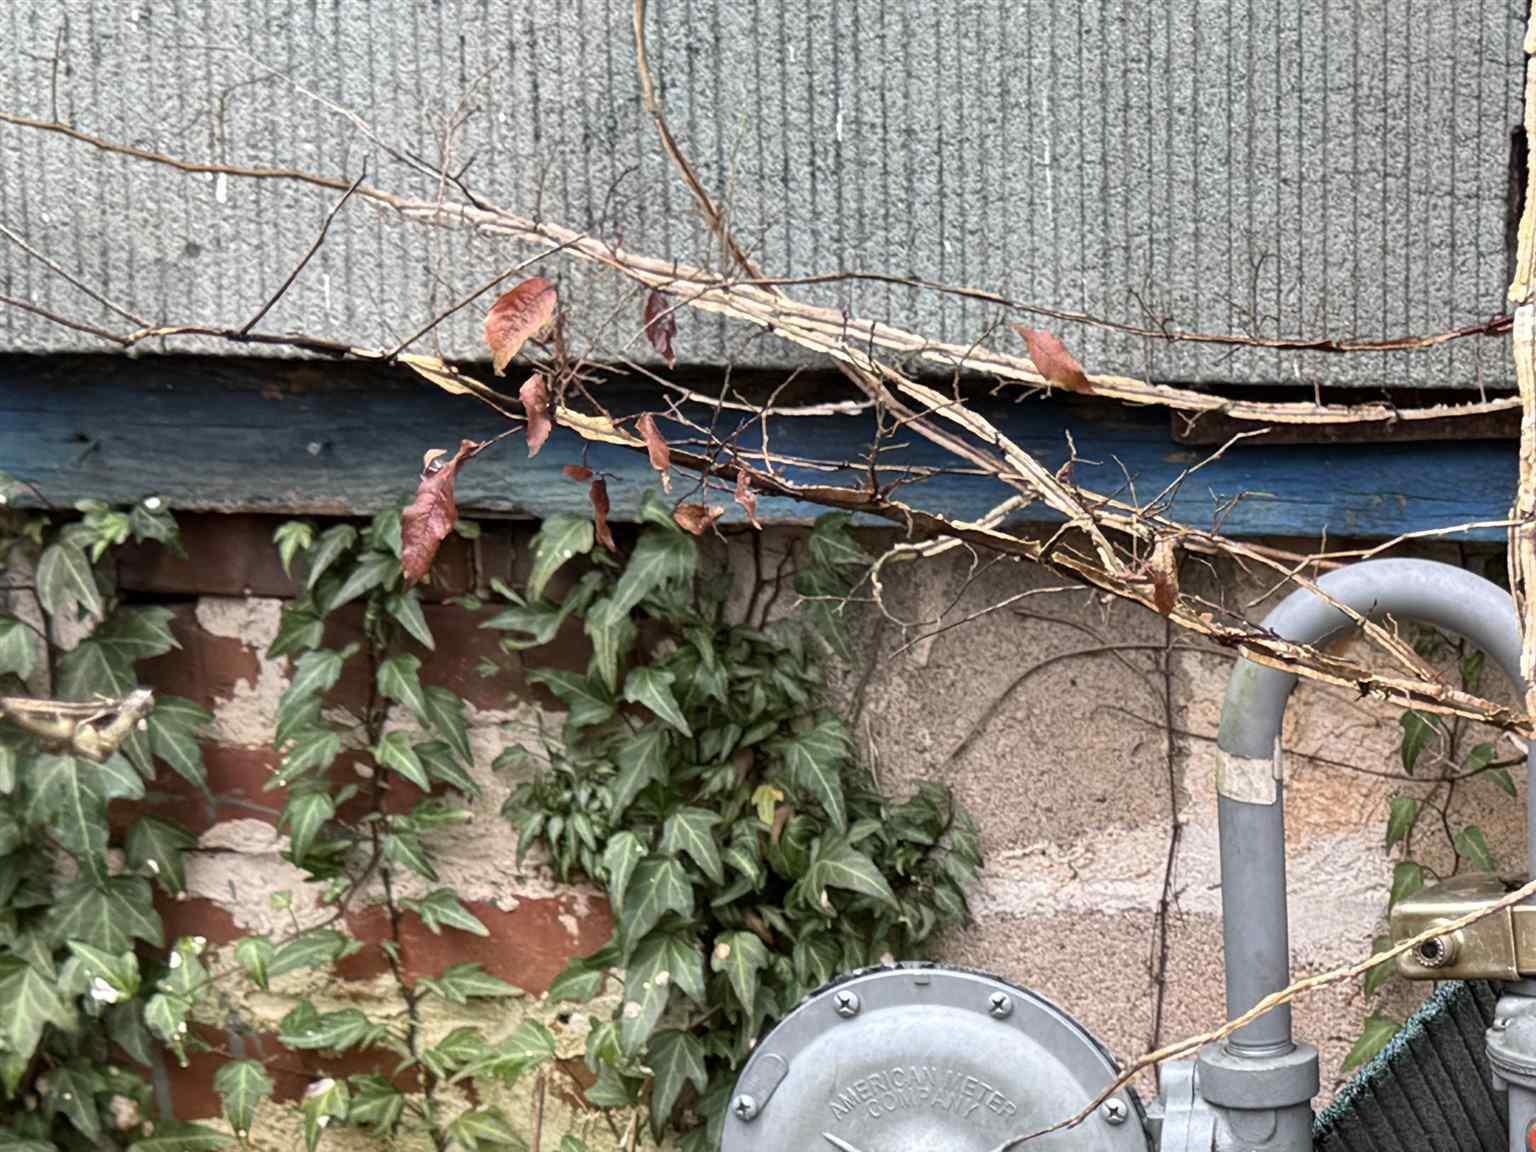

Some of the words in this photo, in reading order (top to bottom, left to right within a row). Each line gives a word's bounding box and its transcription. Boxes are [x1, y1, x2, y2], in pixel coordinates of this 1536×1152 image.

[828, 1065, 937, 1120] AMERICAN
[942, 1070, 1017, 1118] METER
[866, 1086, 980, 1119] COMPANY
